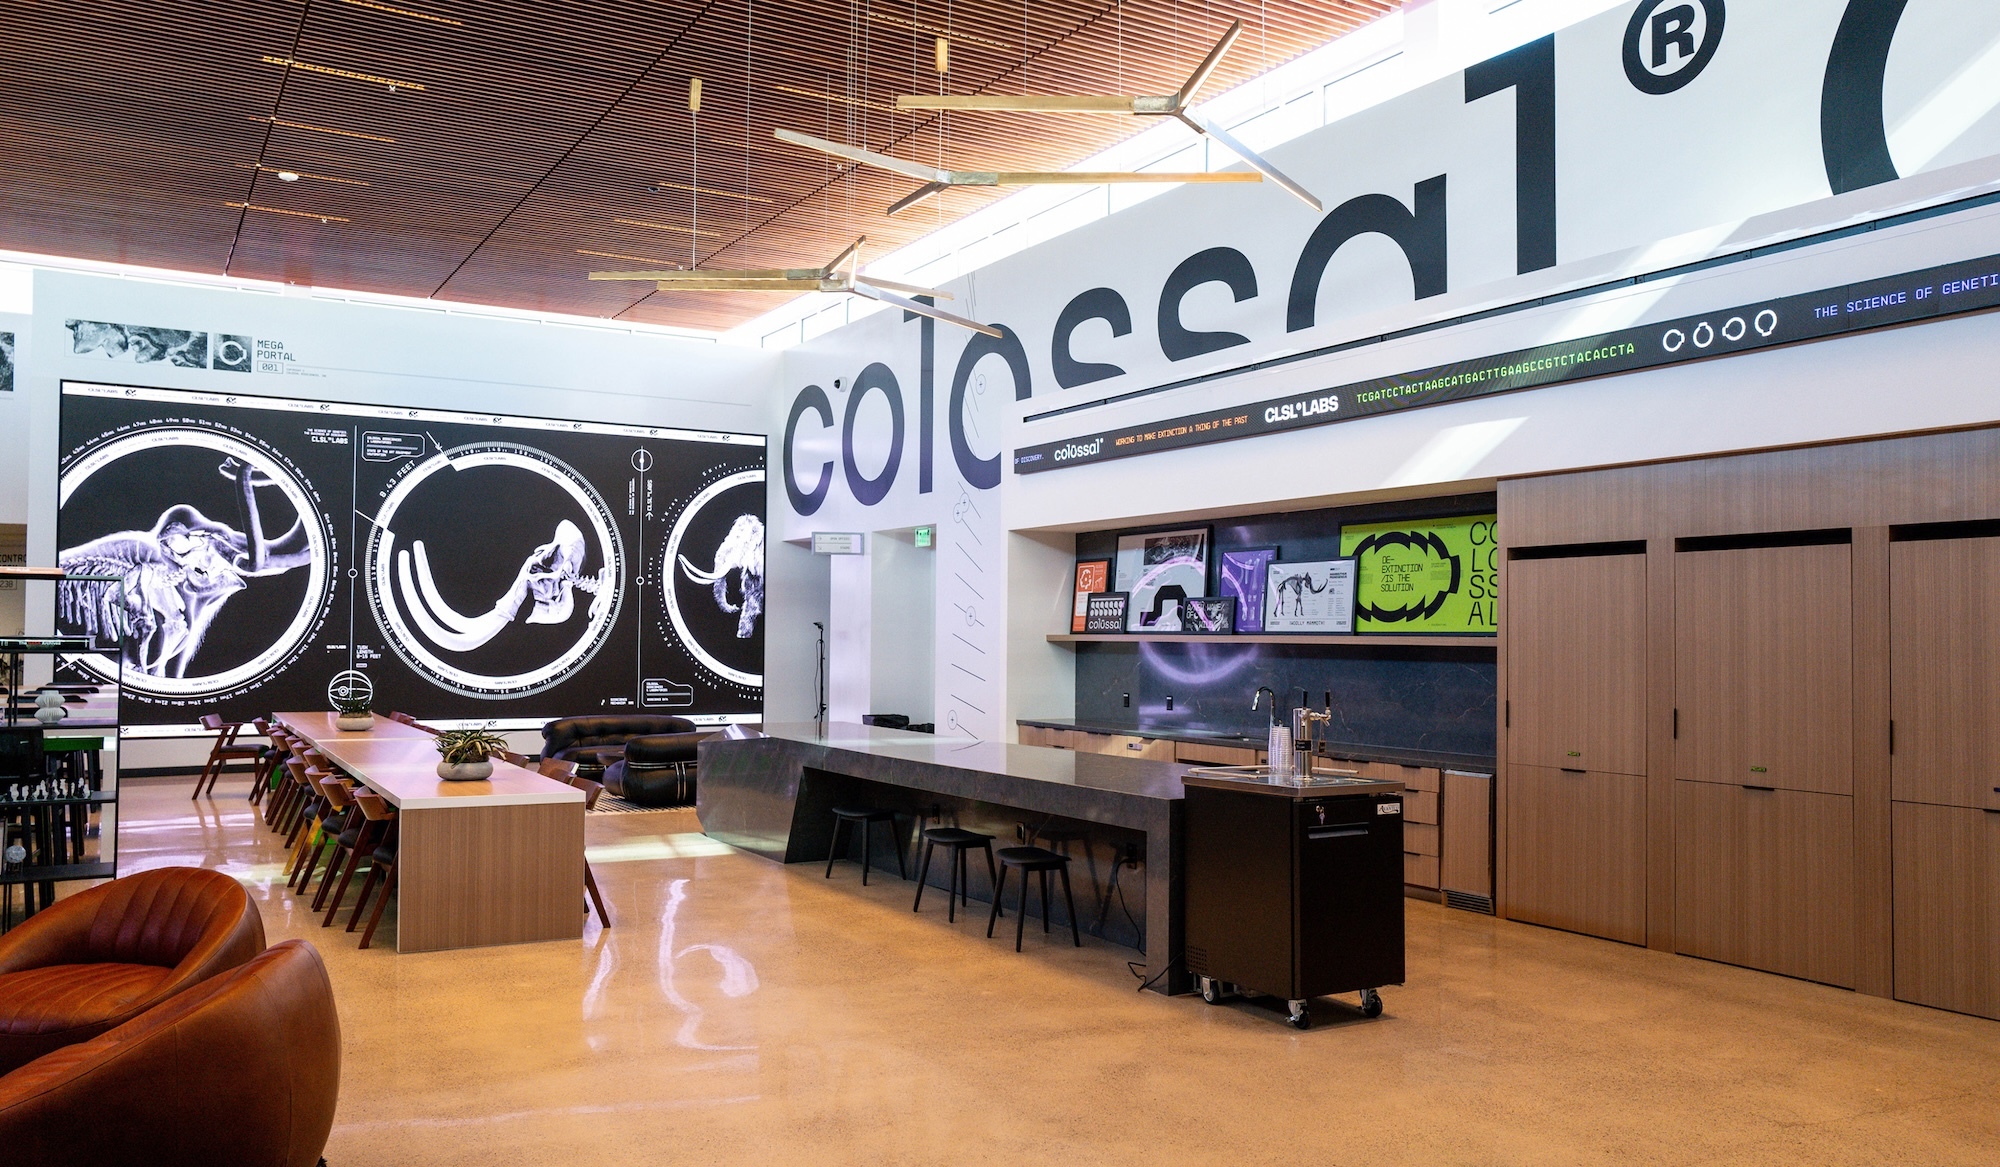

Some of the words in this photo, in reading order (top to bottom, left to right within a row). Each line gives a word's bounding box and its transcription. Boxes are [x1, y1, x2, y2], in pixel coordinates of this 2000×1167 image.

[1815, 305, 1838, 319] THE
[1847, 292, 1906, 313] SCIENCE
[1916, 287, 1932, 300] OF
[1942, 274, 1999, 295] GENETI
[257, 340, 284, 350] MEGA
[257, 350, 296, 361] PORTAL
[262, 363, 278, 371] 001
[1357, 343, 1635, 403] TCGATCCTACTAAGCATGACTTGAAGCCGTCTACACCTA
[1116, 434, 1135, 446] WORKING
[1137, 434, 1143, 442] TO
[1144, 431, 1156, 440] MAKE
[1158, 426, 1187, 439] EXTINCTION
[1189, 425, 1193, 433] A
[1195, 421, 1211, 432] THING
[1212, 419, 1220, 429] OF
[1222, 418, 1232, 427] THE
[1234, 415, 1248, 425] PAST
[396, 459, 416, 478] FEET
[0, 554, 26, 563] ONTR
[1382, 556, 1394, 564] DE-
[1381, 564, 1423, 573] EXTINCTION
[1398, 574, 1410, 582] THE
[1381, 584, 1414, 592] SOLUTION
